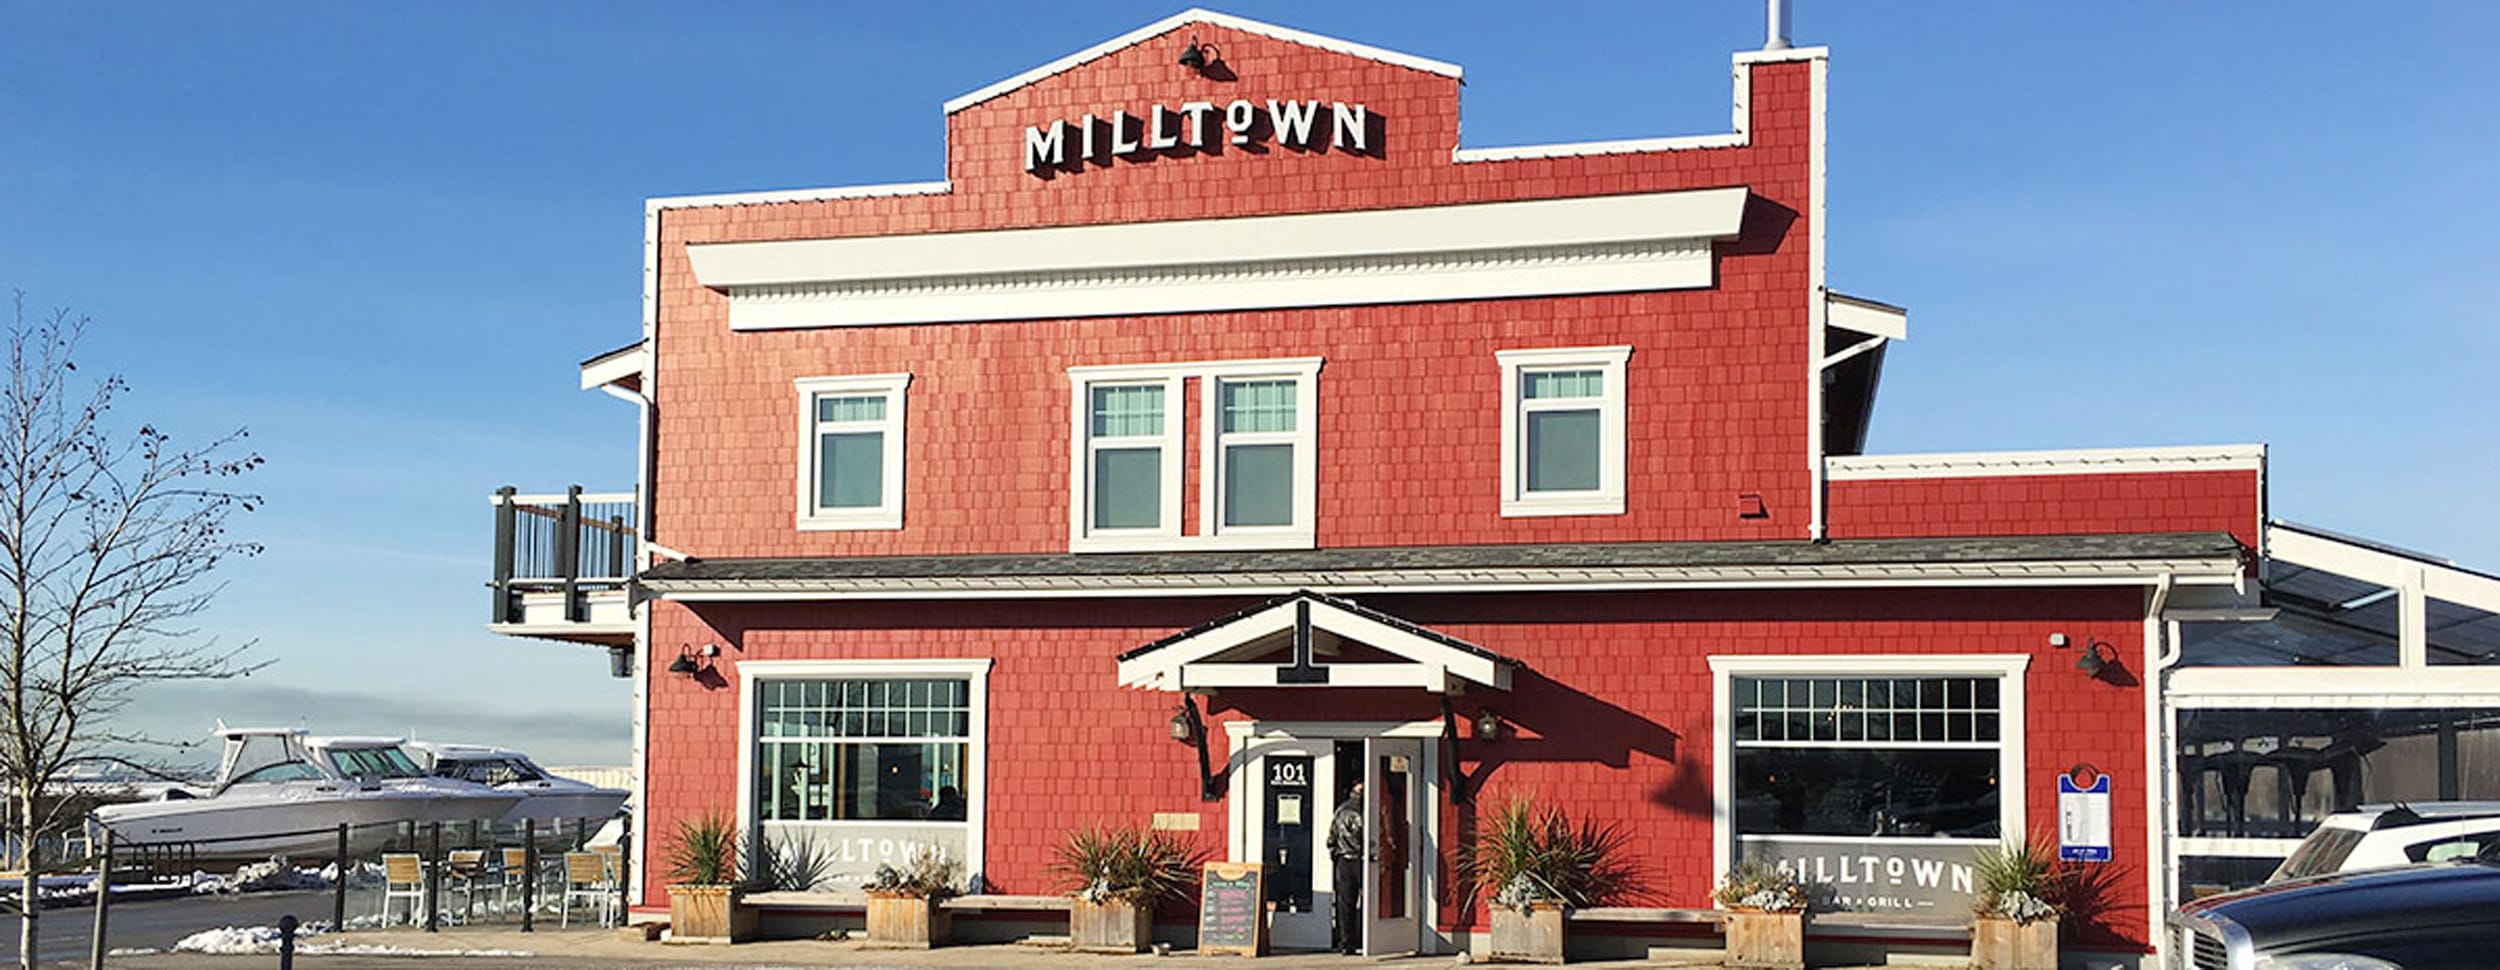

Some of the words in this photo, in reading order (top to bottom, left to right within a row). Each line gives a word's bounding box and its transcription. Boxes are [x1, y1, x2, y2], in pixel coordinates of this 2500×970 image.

[1025, 99, 1366, 171] MILLTOWN
[1273, 763, 1305, 780] 101
[781, 837, 947, 866] LTOWN
[1867, 896, 1913, 908] GRILL
